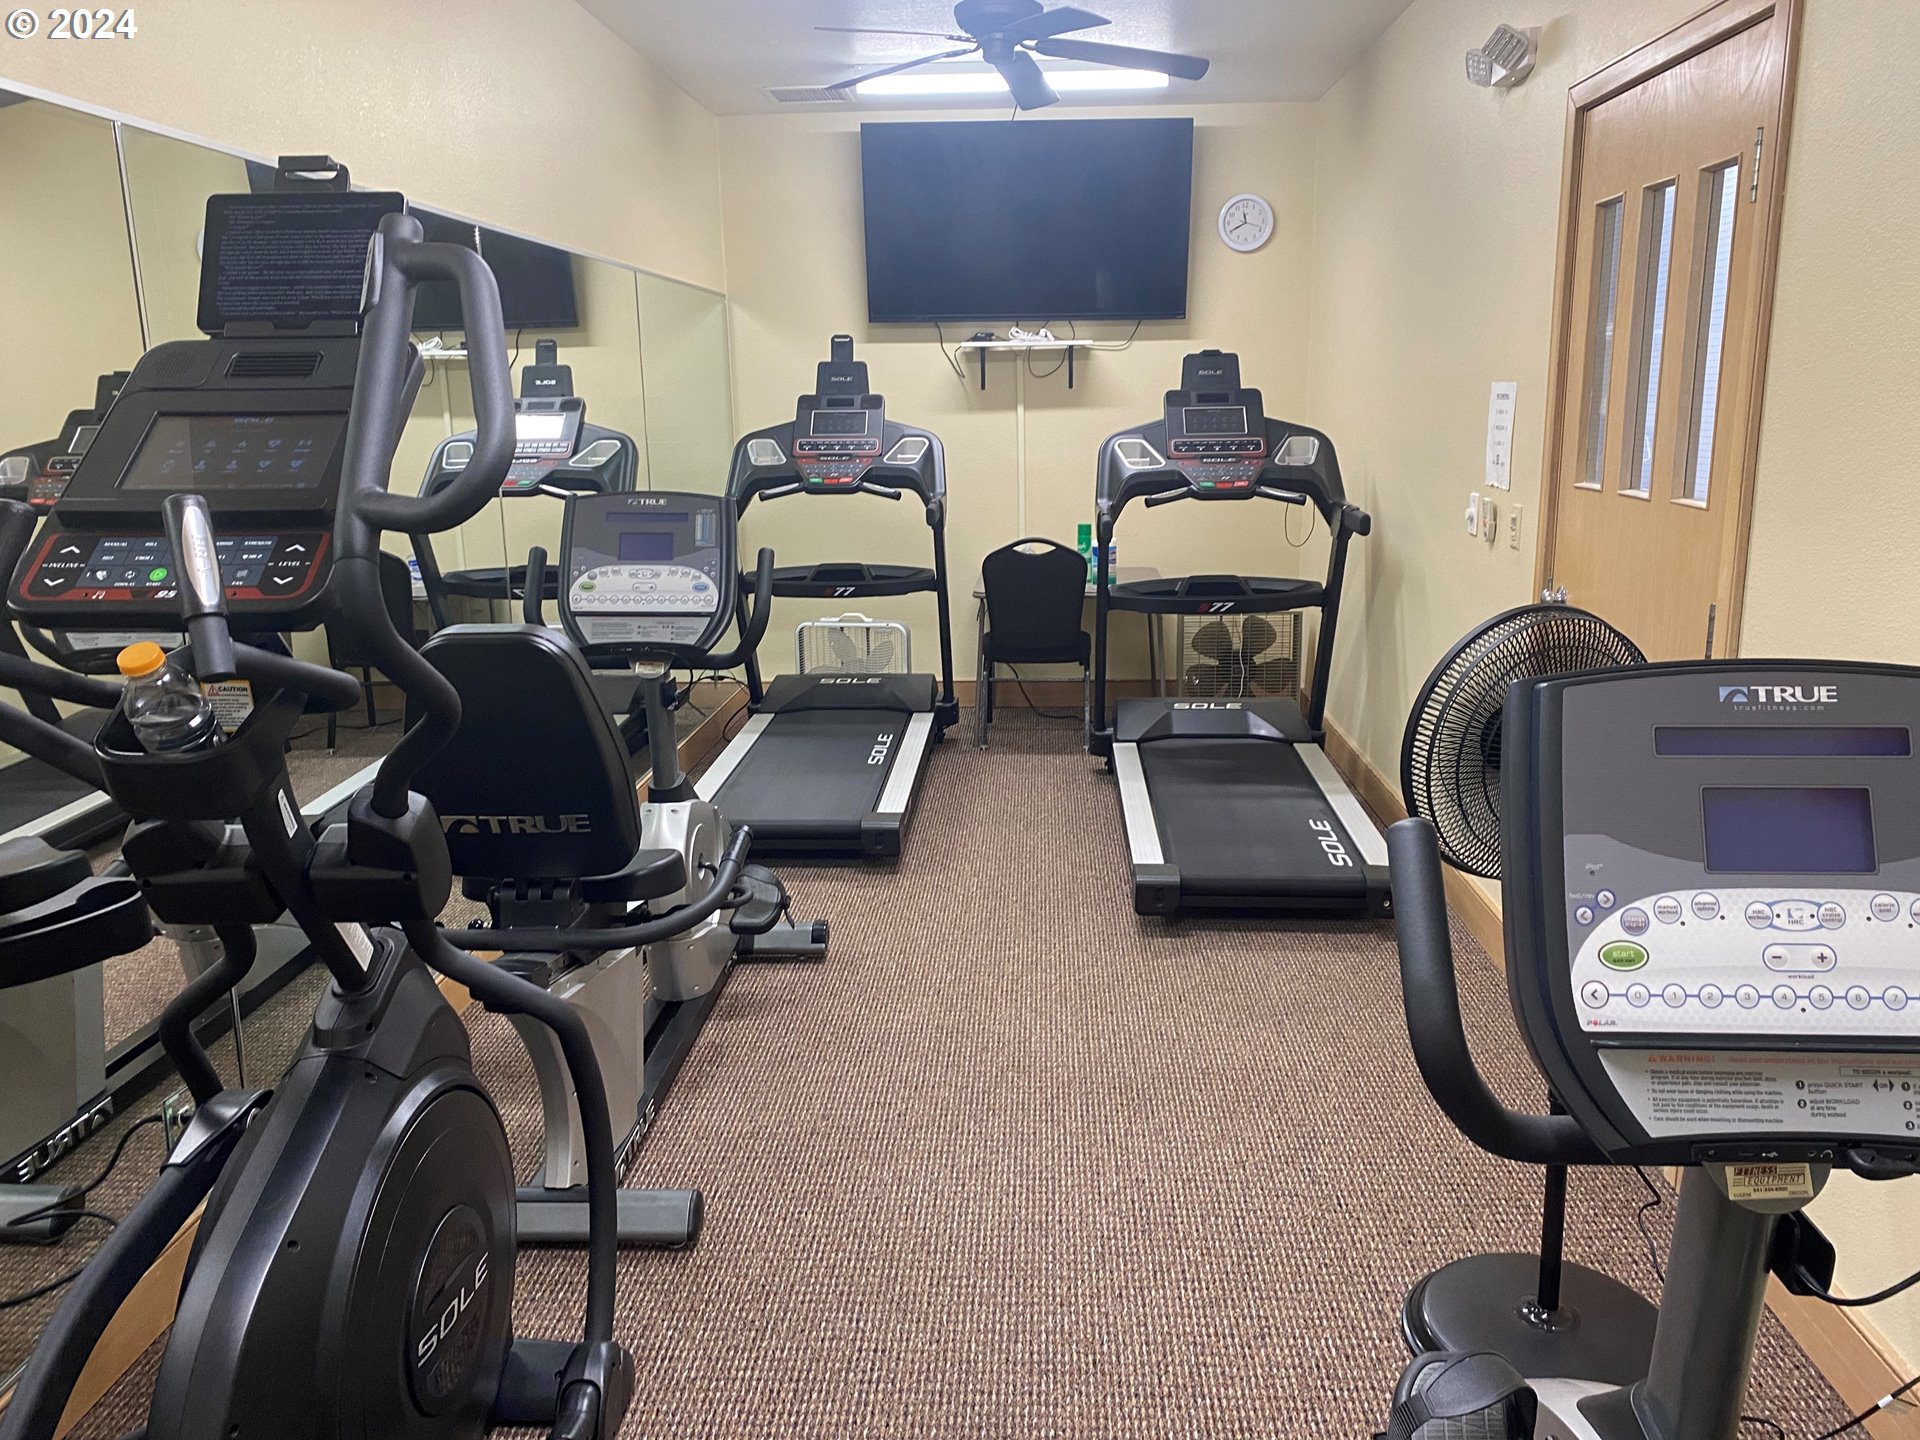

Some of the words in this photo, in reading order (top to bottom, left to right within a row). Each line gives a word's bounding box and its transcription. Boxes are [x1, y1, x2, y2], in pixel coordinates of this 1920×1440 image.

[1750, 686, 1838, 702] TRUE
[1174, 702, 1242, 710] SOLE
[868, 733, 894, 765] SOLE
[479, 814, 591, 834] TRUE
[1309, 818, 1353, 867] SOLE
[1612, 950, 1635, 958] start
[1734, 1166, 1777, 1176] FITNESS
[1747, 1175, 1801, 1185] EQUIPMENT
[418, 1251, 489, 1368] SOLE
